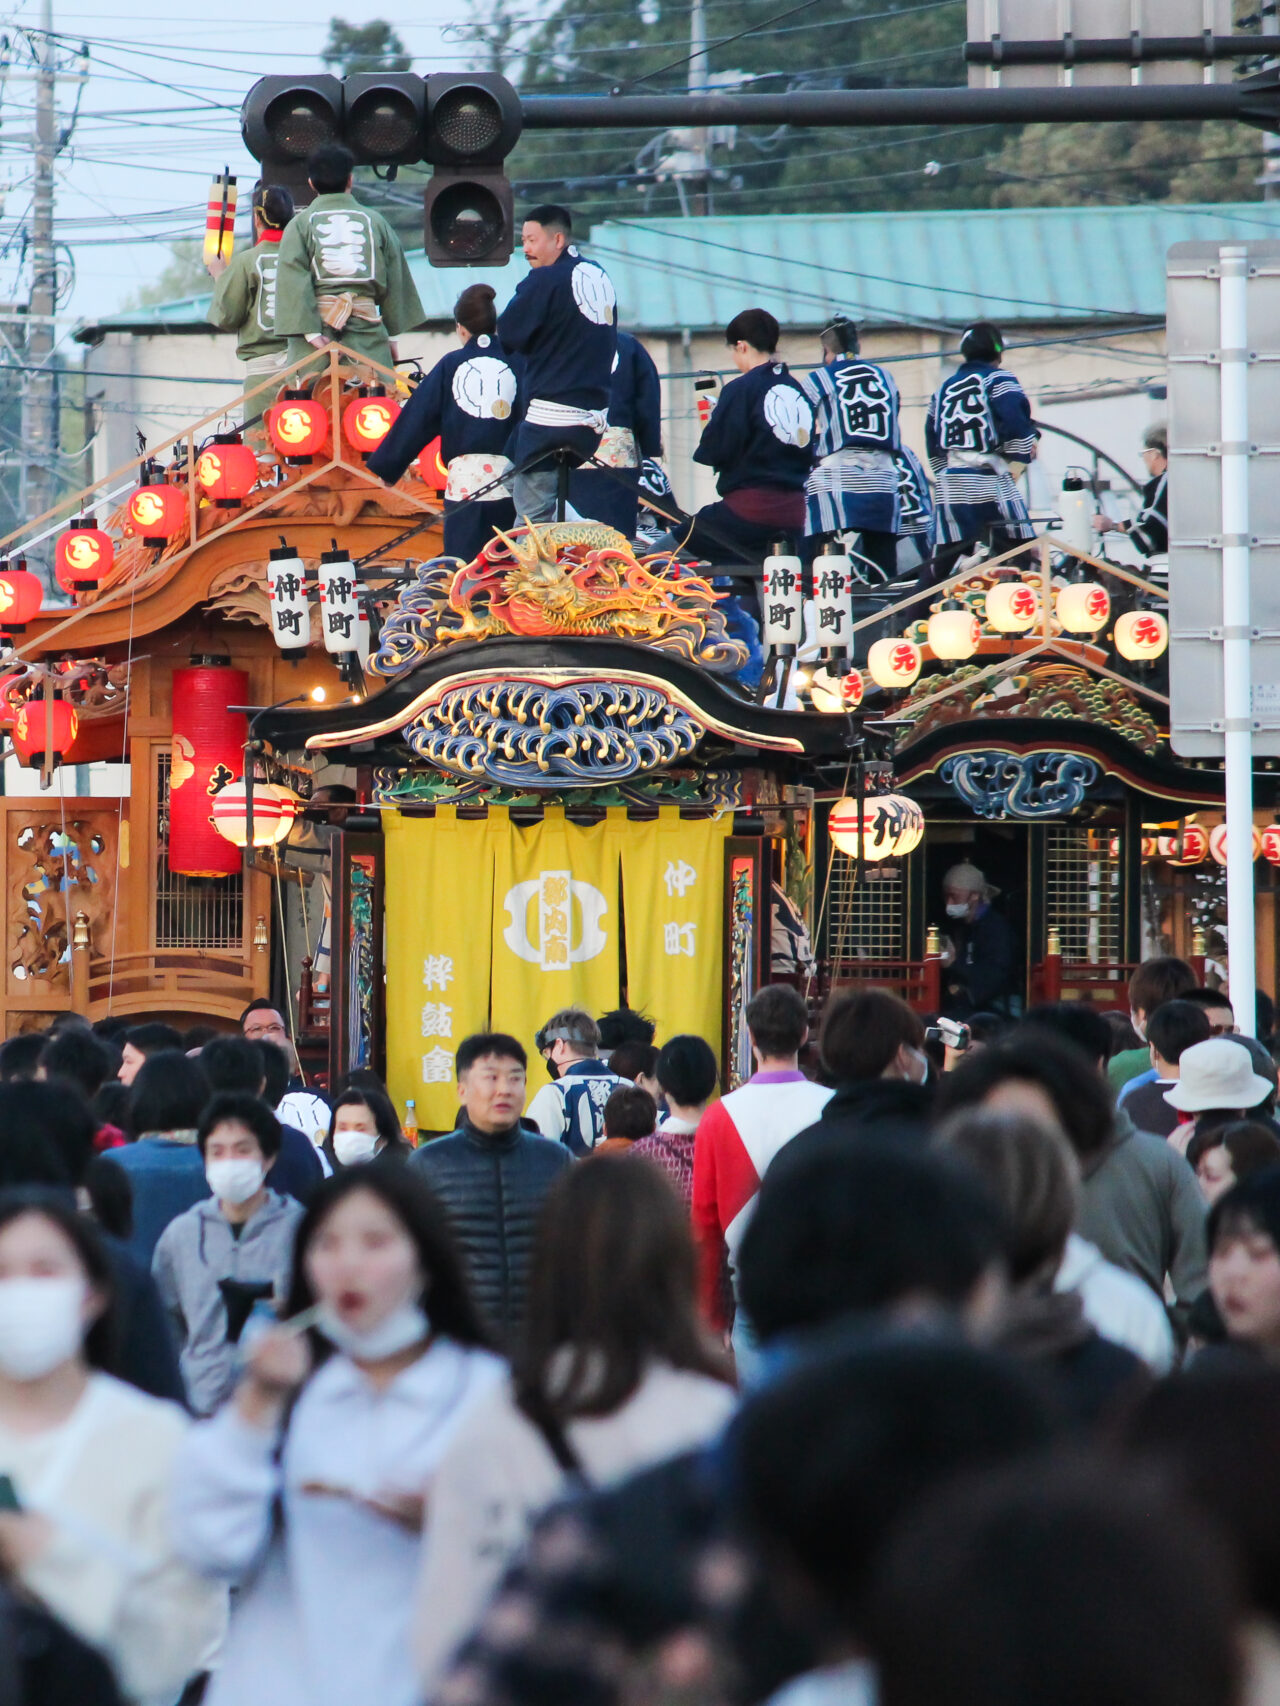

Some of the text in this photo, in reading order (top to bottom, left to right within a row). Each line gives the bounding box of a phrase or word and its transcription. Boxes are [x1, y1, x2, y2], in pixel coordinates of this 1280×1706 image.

[315, 214, 367, 276] 大手
[839, 366, 889, 438] 元町
[943, 376, 987, 452] 元町
[275, 573, 304, 636] 仲町
[326, 577, 355, 638] 仲町
[769, 568, 796, 631] 仲町
[818, 570, 846, 635] 仲町
[1014, 590, 1034, 616] 元
[1089, 591, 1107, 617] 元
[893, 645, 916, 671] 元
[1135, 618, 1160, 644] 元
[843, 674, 862, 699] 元
[663, 859, 697, 957] 仲町
